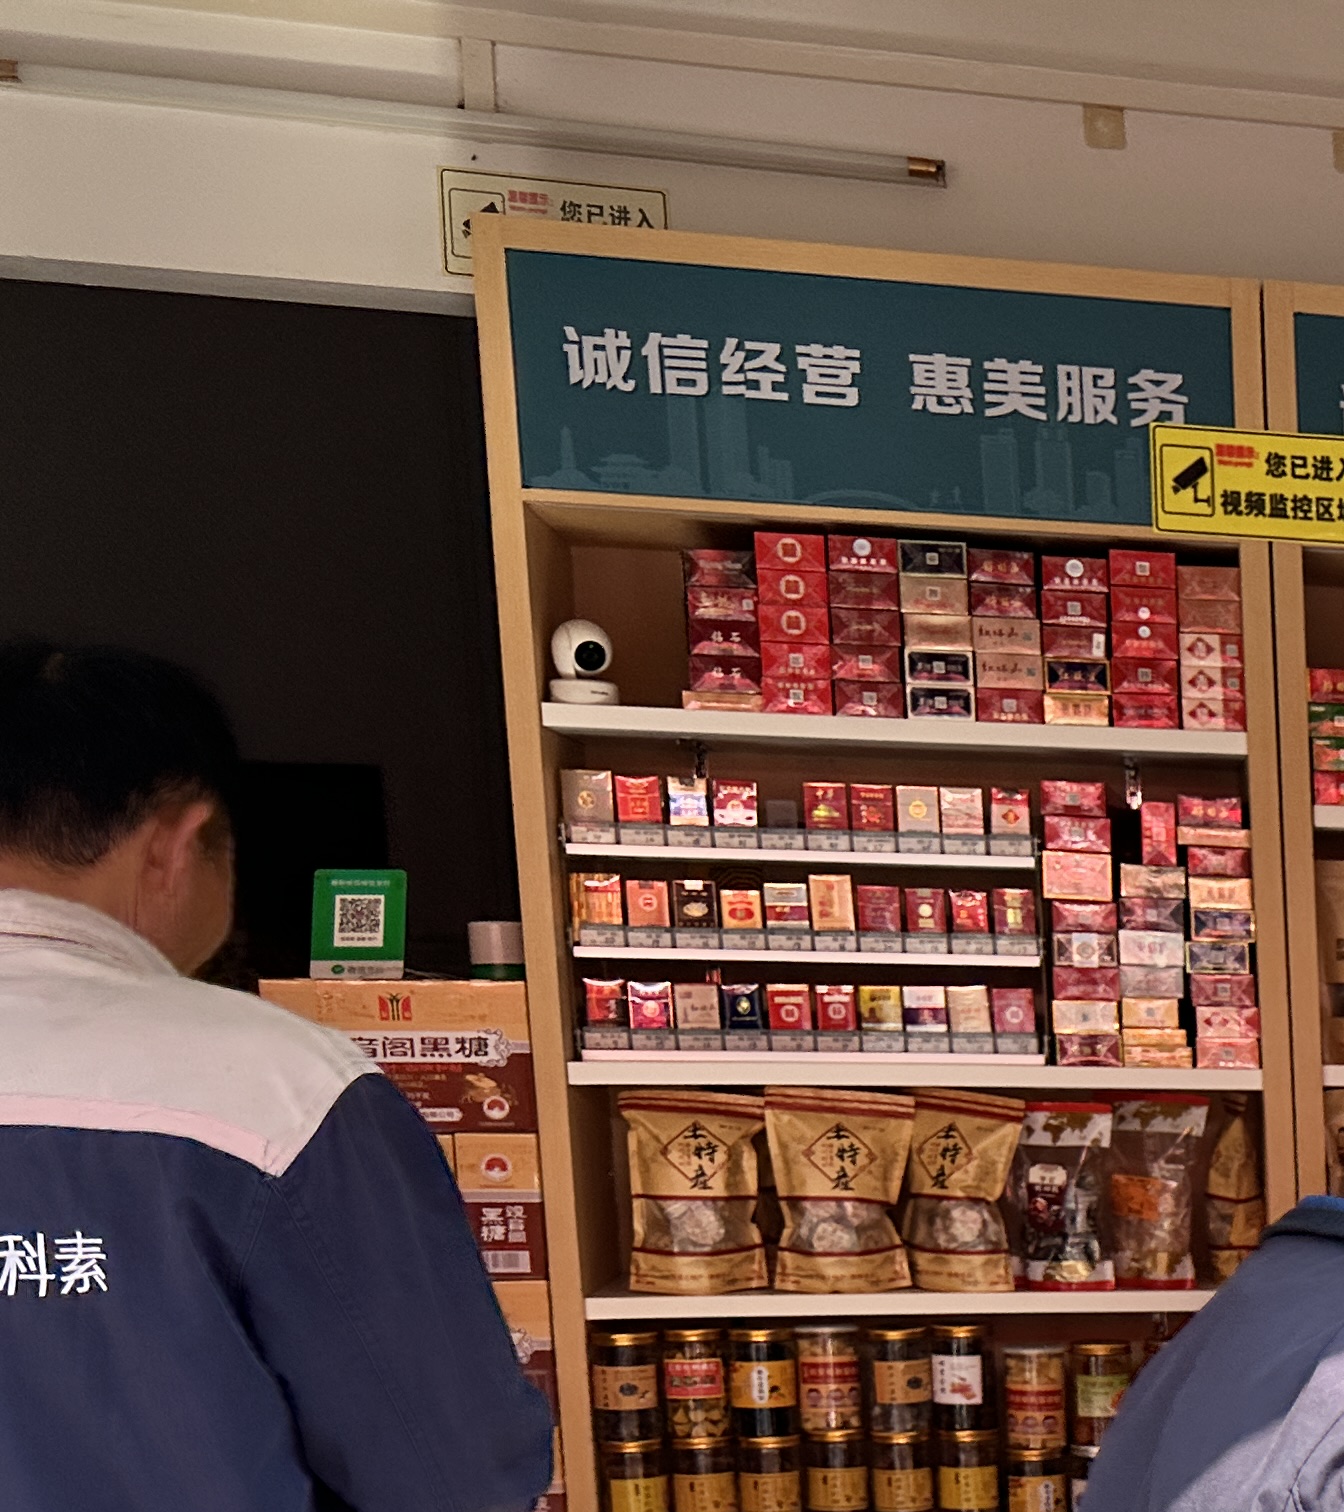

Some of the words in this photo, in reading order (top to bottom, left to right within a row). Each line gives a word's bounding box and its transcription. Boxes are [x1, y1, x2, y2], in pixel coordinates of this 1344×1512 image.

[563, 325, 861, 406] 诚信经营
[908, 352, 1189, 428] 惠美服务
[0, 1231, 108, 1298] 科素
